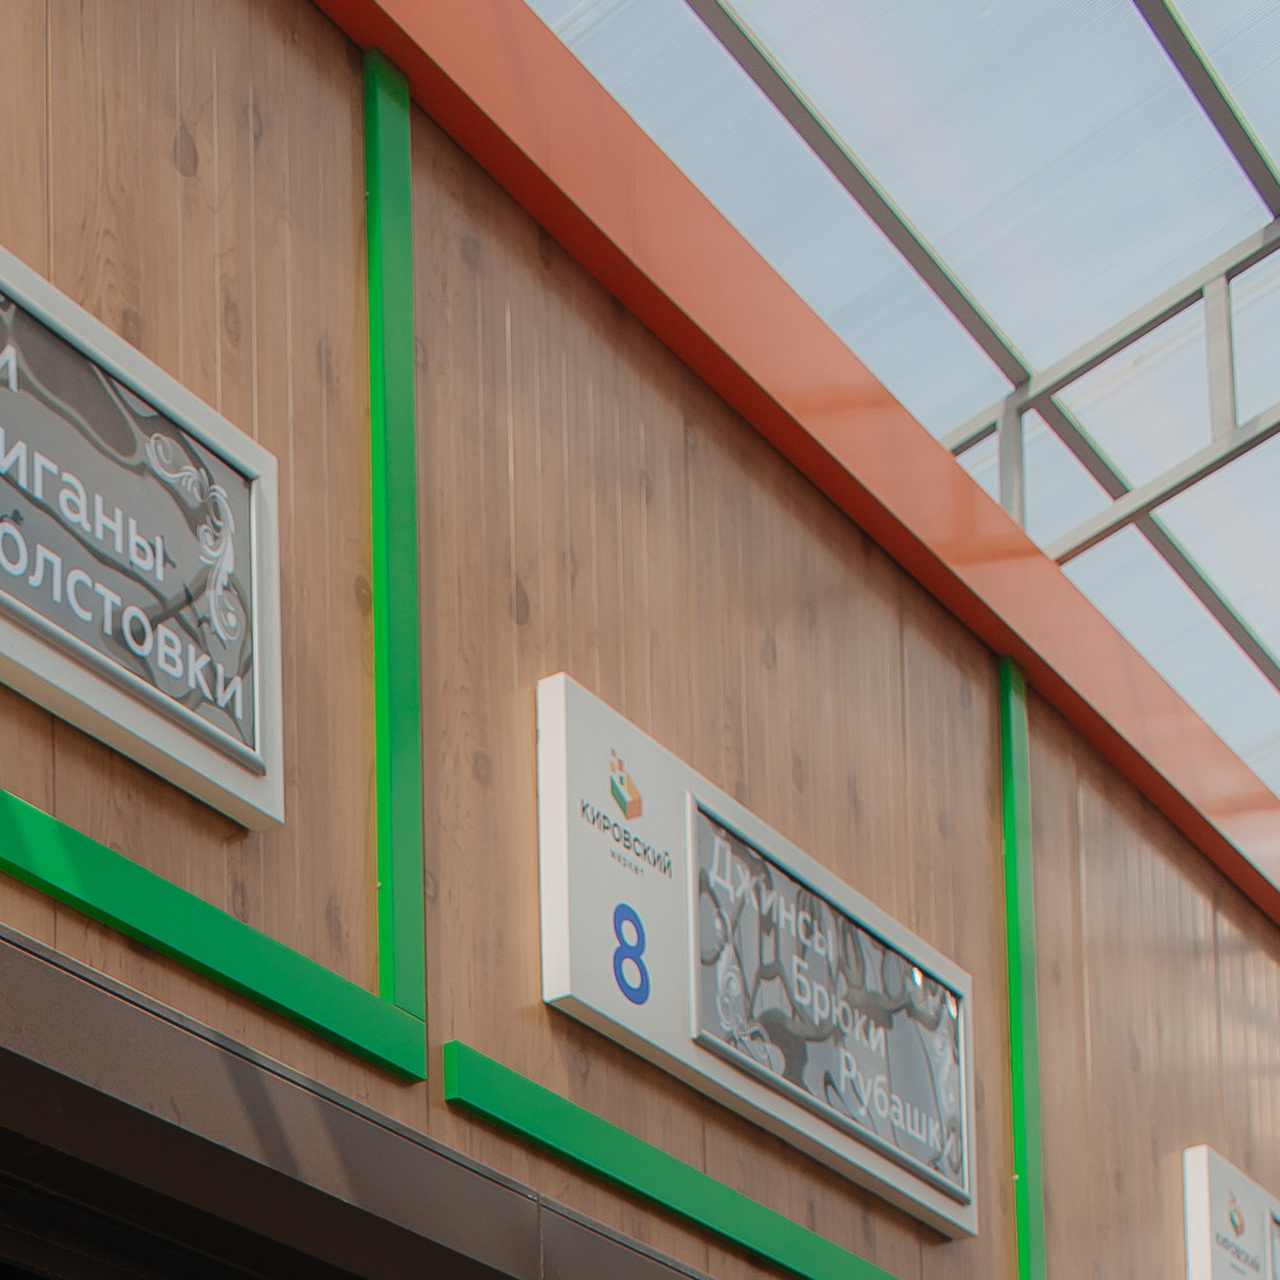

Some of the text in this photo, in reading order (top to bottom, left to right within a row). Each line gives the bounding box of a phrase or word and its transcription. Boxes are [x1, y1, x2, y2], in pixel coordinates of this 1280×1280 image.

[580, 798, 672, 879] КИРОВСКИЙ
[707, 832, 835, 962] Джинсы
[613, 903, 651, 1005] 8
[793, 954, 886, 1057] Брюки
